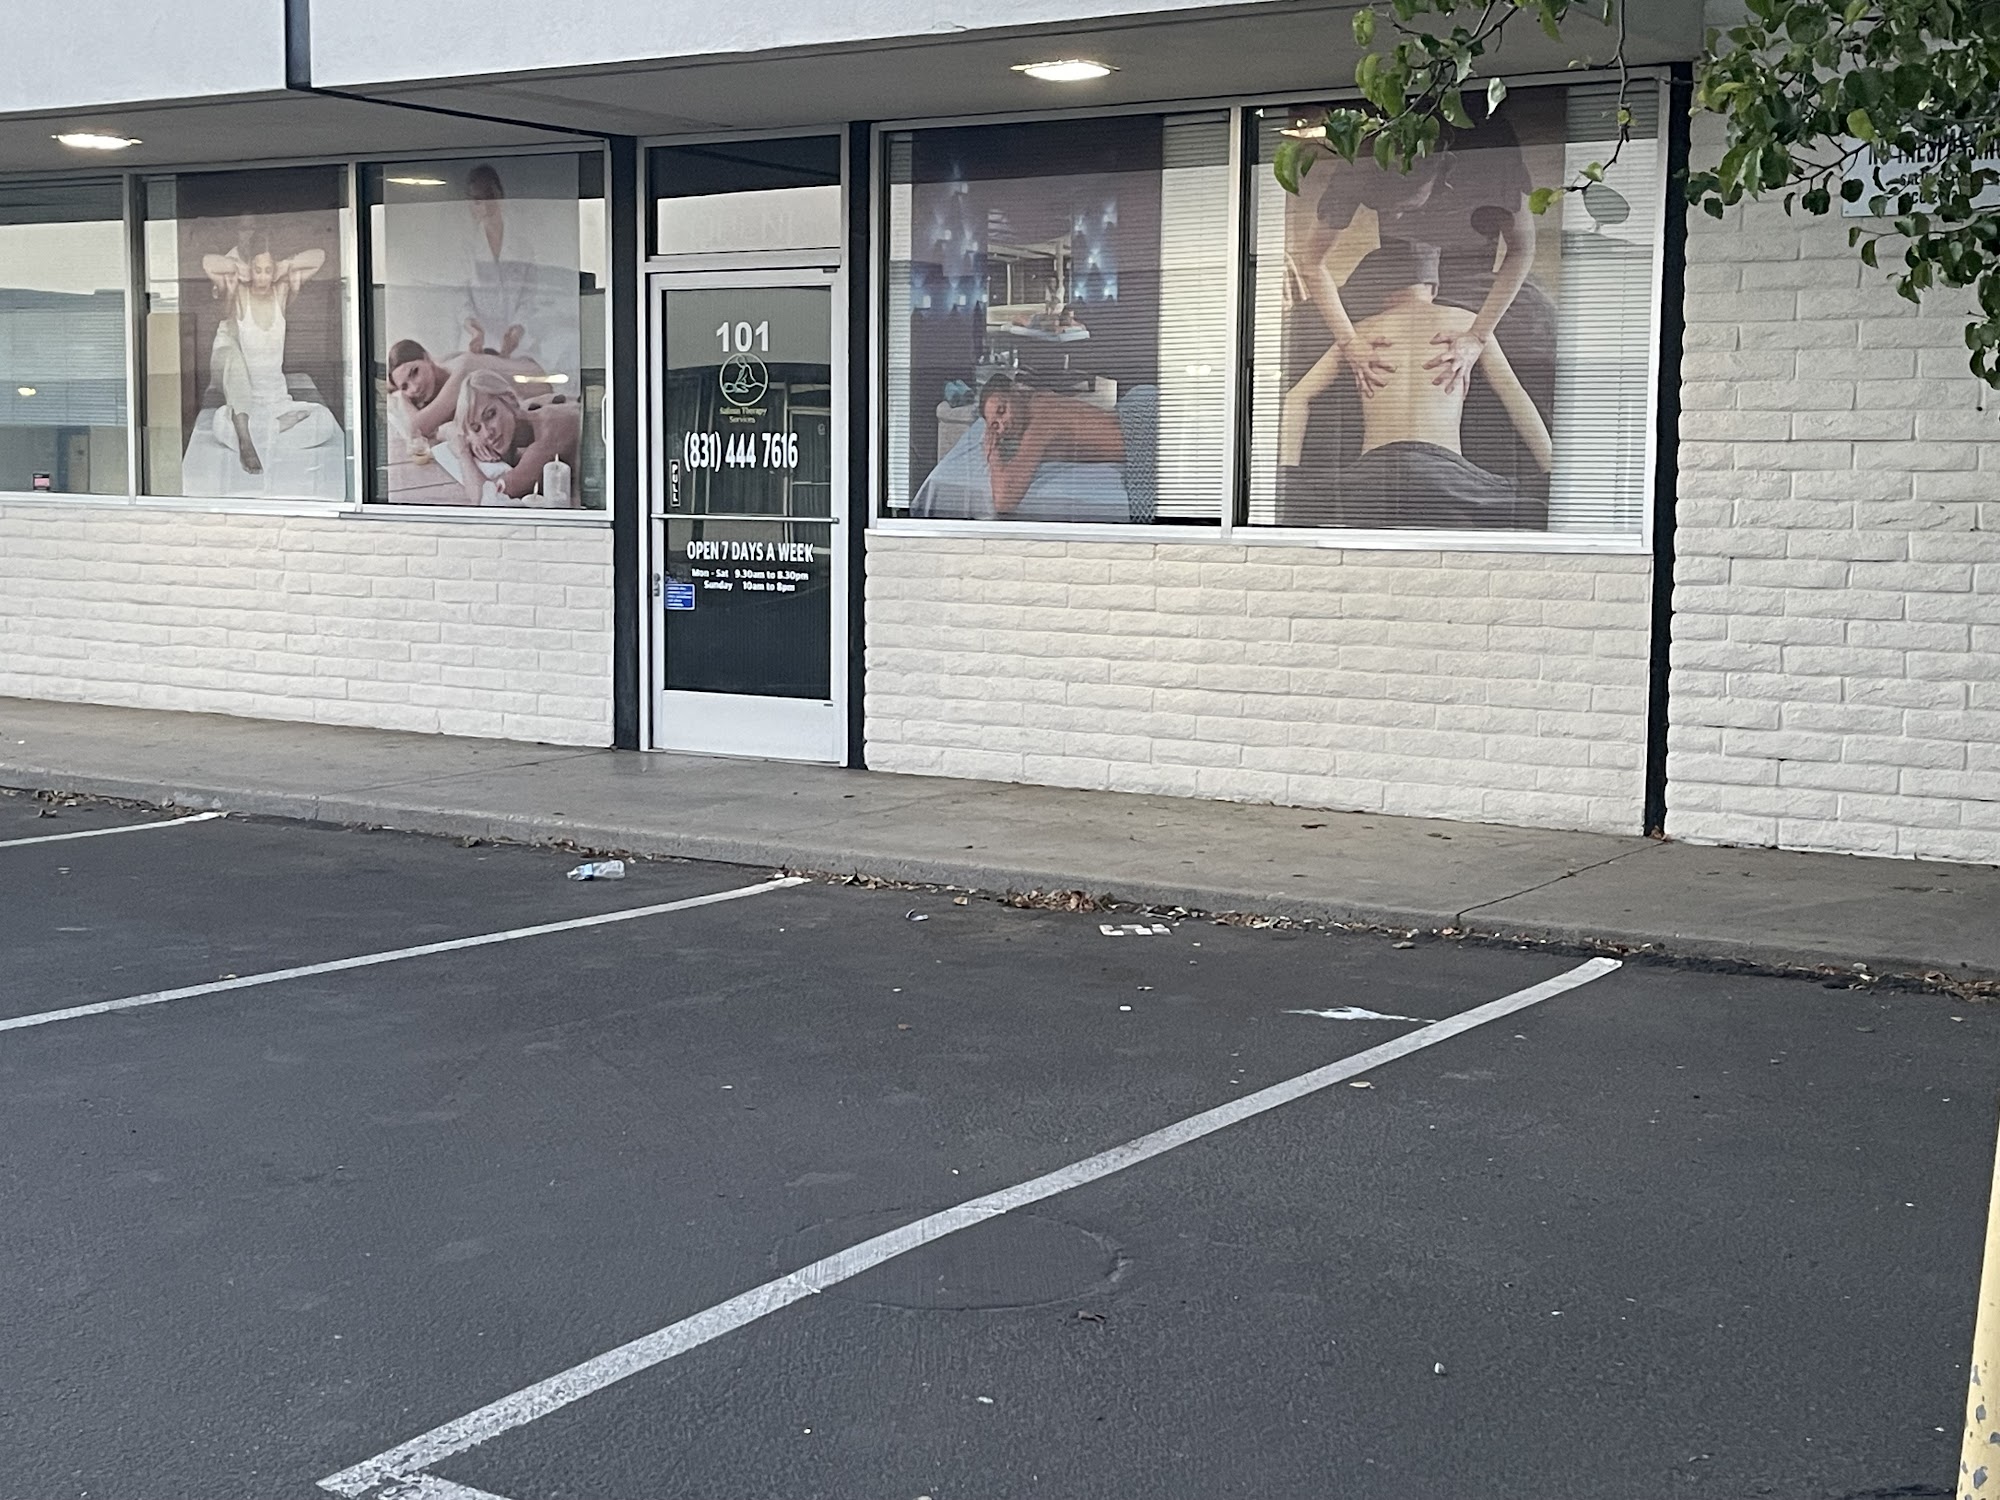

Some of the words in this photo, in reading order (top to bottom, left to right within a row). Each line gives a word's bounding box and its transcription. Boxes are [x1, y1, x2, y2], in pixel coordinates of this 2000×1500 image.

[716, 321, 769, 352] 101
[684, 431, 722, 472] (831)
[725, 433, 756, 469] 444
[762, 433, 798, 469] 7616
[671, 463, 679, 502] PULL
[686, 541, 719, 560] OPEN
[721, 541, 729, 560] 7
[732, 542, 764, 562] DAYS
[766, 543, 776, 562] A
[778, 543, 814, 563] WEEK
[691, 568, 710, 578] Mon
[715, 569, 729, 578] Sat
[766, 570, 776, 579] to
[703, 580, 733, 591] Sunday
[742, 581, 765, 591] 10am
[766, 582, 775, 592] to
[776, 582, 796, 593] 8pm
